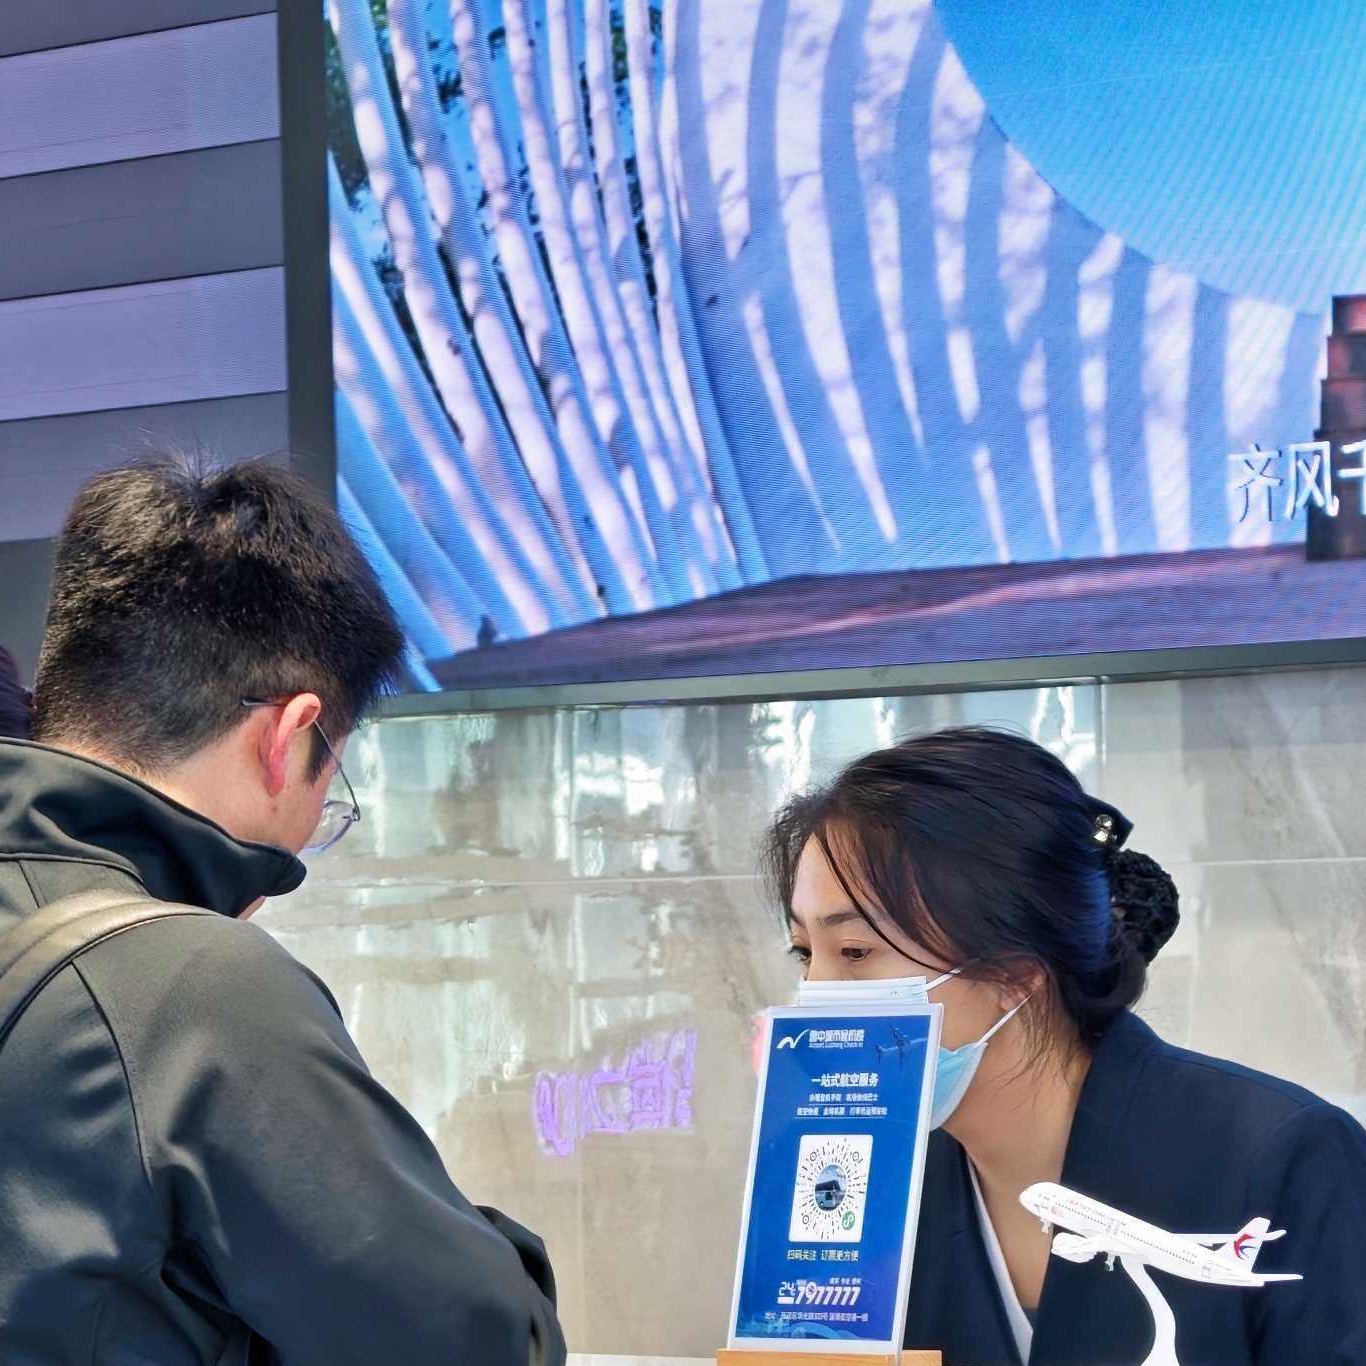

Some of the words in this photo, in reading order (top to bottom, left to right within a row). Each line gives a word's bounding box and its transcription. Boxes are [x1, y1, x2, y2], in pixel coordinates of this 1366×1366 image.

[811, 1072, 878, 1087] 一站式航空服务
[795, 1281, 861, 1306] 7977777
